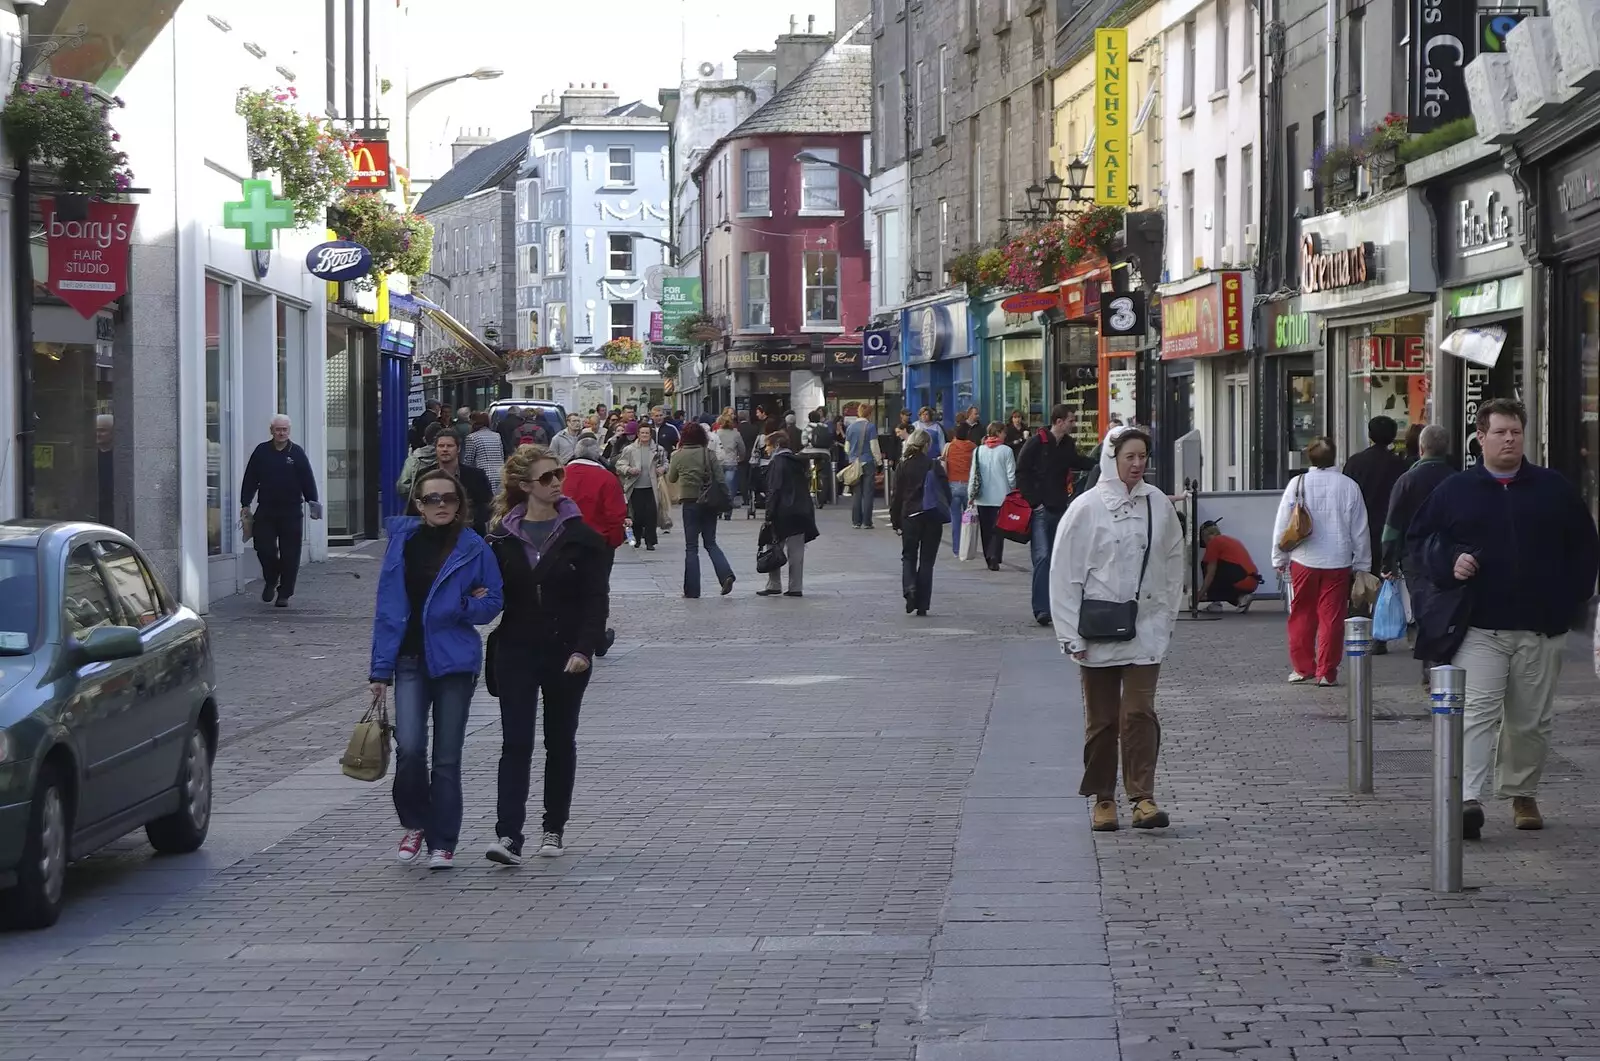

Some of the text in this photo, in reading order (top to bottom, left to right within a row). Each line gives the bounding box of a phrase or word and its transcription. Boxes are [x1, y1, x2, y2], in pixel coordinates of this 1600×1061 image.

[1424, 34, 1464, 118] Cafe
[1104, 37, 1120, 199] LYNCHS CAFE
[51, 212, 127, 248] barry's
[66, 262, 110, 274] STUDIO
[74, 250, 102, 260] HAIR
[312, 247, 362, 273] Boots
[1301, 232, 1368, 293] Brennans
[664, 286, 681, 294] FOR
[664, 293, 686, 301] SALE
[1109, 296, 1137, 331] 3
[1226, 279, 1239, 345] GIFTS
[771, 352, 806, 363] sons
